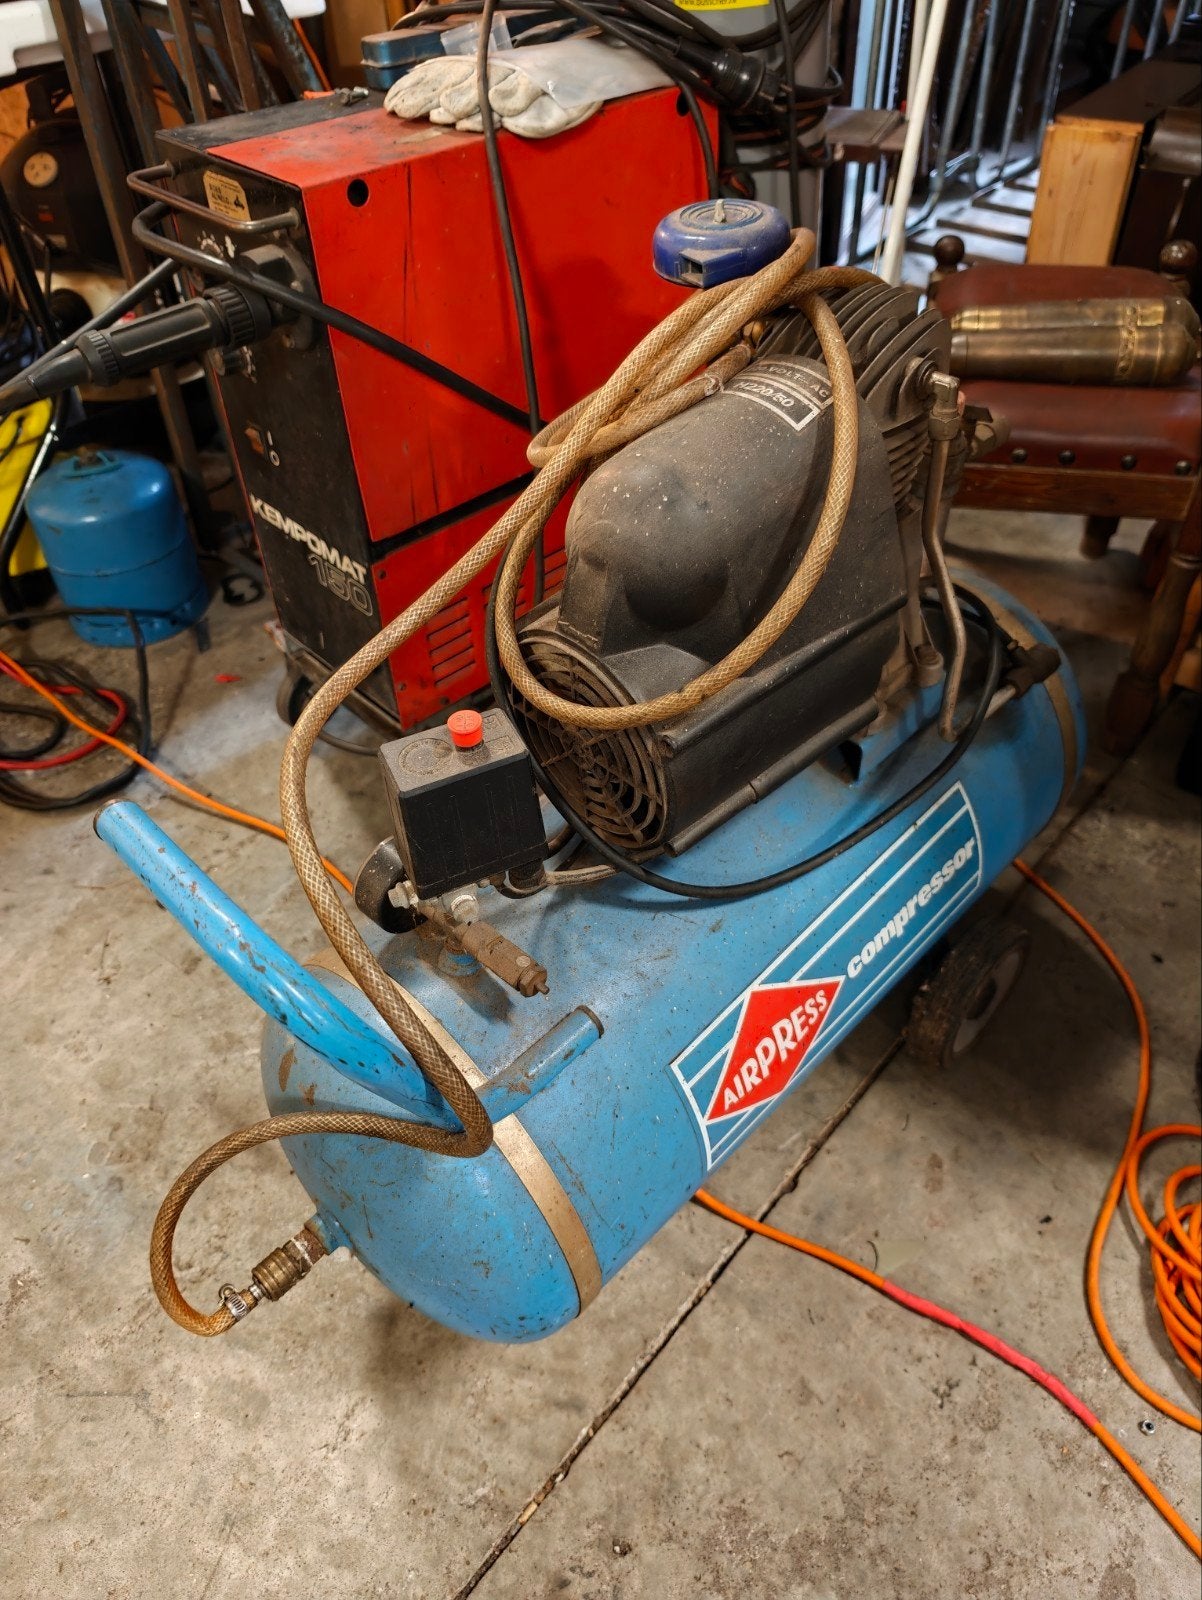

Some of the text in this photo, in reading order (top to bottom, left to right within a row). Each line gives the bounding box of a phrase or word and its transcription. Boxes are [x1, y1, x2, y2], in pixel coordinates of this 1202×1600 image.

[249, 493, 367, 584] KEMPOMAT
[307, 553, 374, 617] 150
[846, 837, 976, 979] compressor
[722, 988, 829, 1111] AIRPRESS
